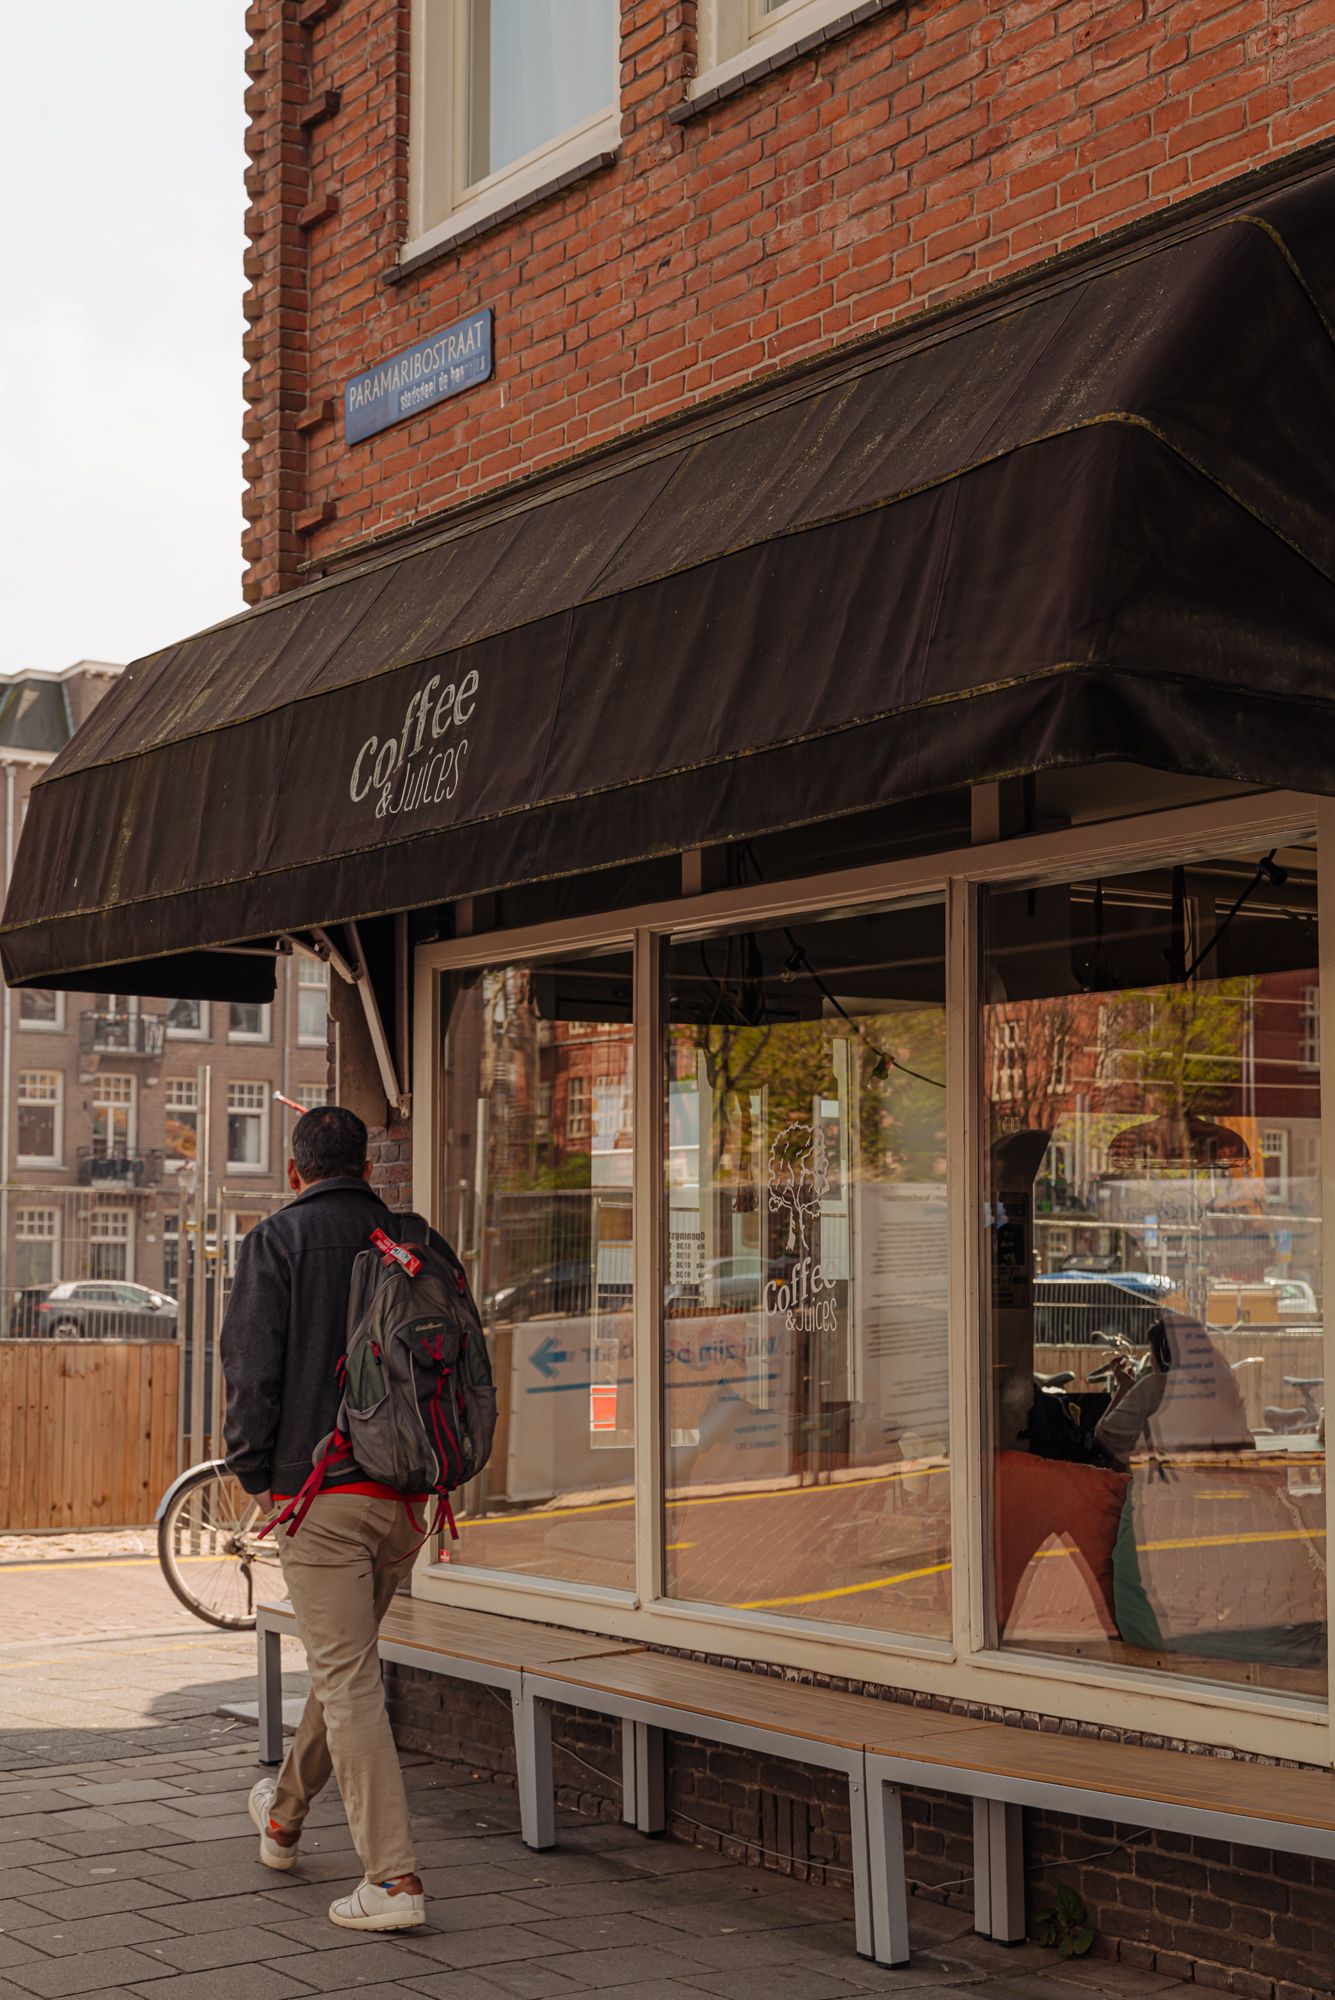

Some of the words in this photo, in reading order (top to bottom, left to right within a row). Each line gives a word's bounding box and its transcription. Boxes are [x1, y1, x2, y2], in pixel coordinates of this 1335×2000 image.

[349, 320, 485, 413] PARAMARIBOSTRAAT
[350, 669, 479, 803] Coffee
[763, 1256, 837, 1316] Coffee
